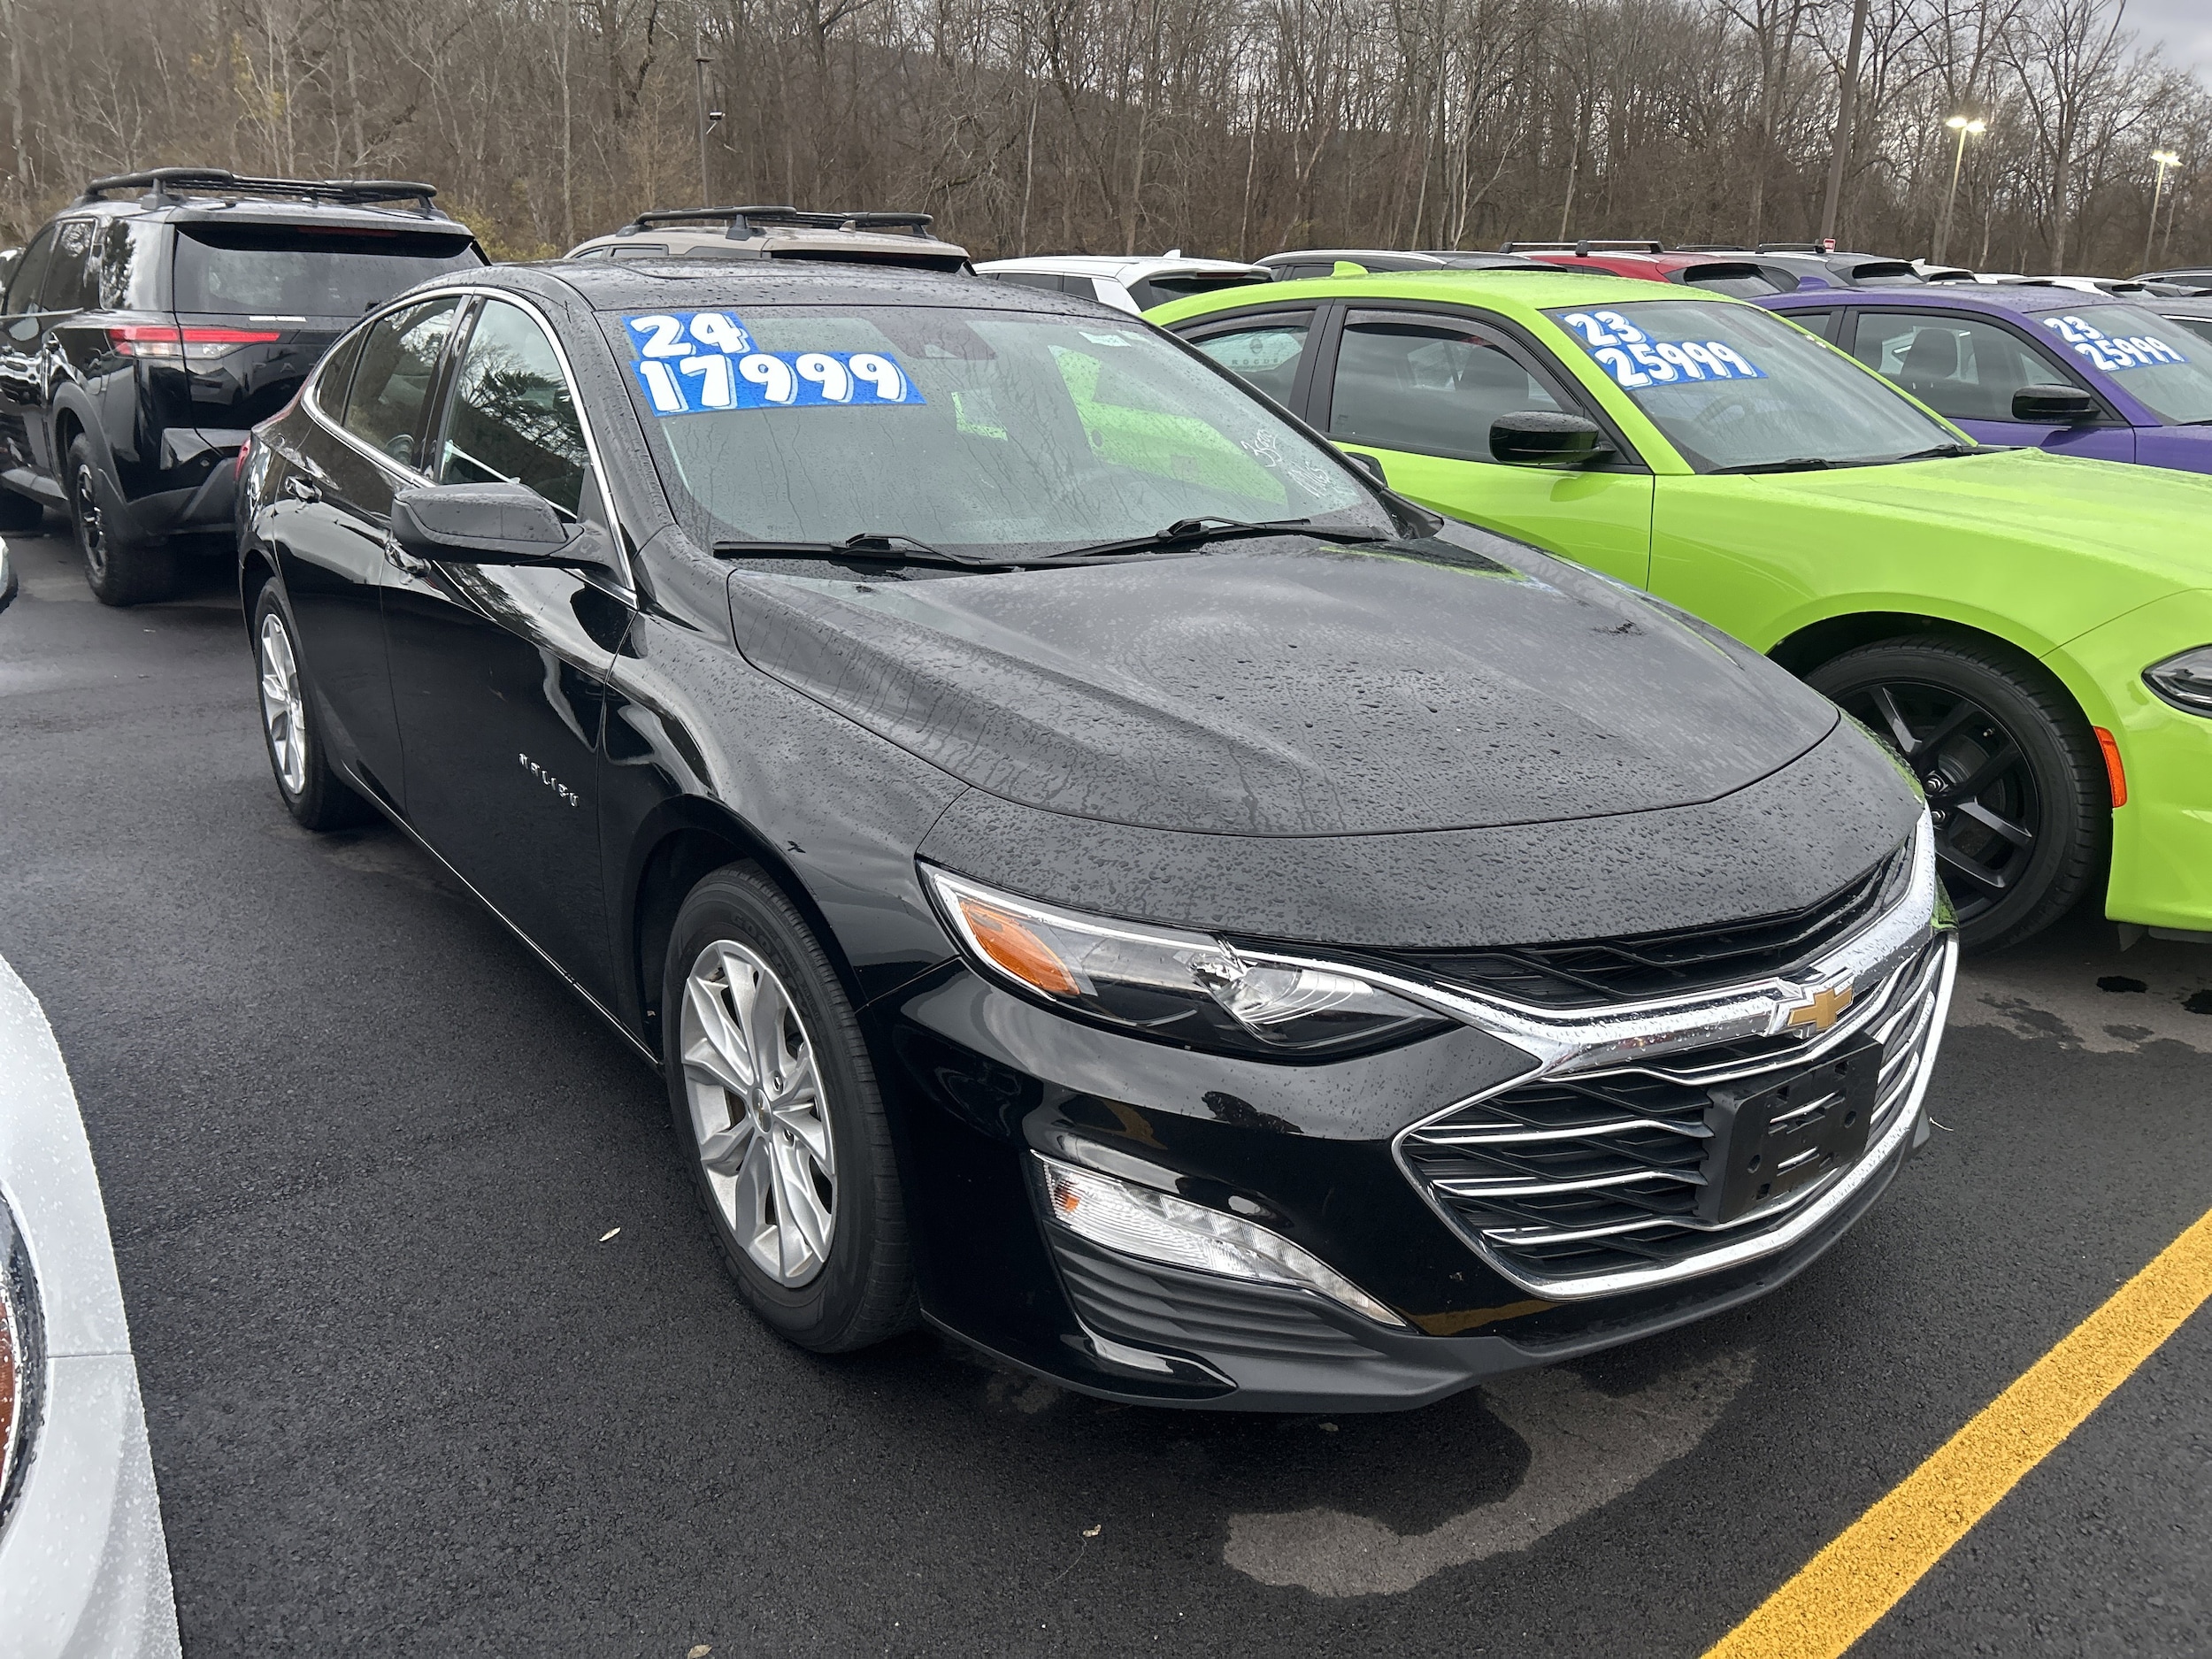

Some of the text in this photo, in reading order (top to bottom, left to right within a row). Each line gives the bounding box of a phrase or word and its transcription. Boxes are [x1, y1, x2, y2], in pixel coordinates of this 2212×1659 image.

[630, 312, 750, 357] 24
[1564, 311, 1647, 347] 23
[2043, 316, 2105, 343] 23
[1594, 341, 1758, 388] 25999
[2074, 335, 2185, 372] 25999
[639, 354, 908, 413] 17999
[518, 753, 580, 807] MALIBU
